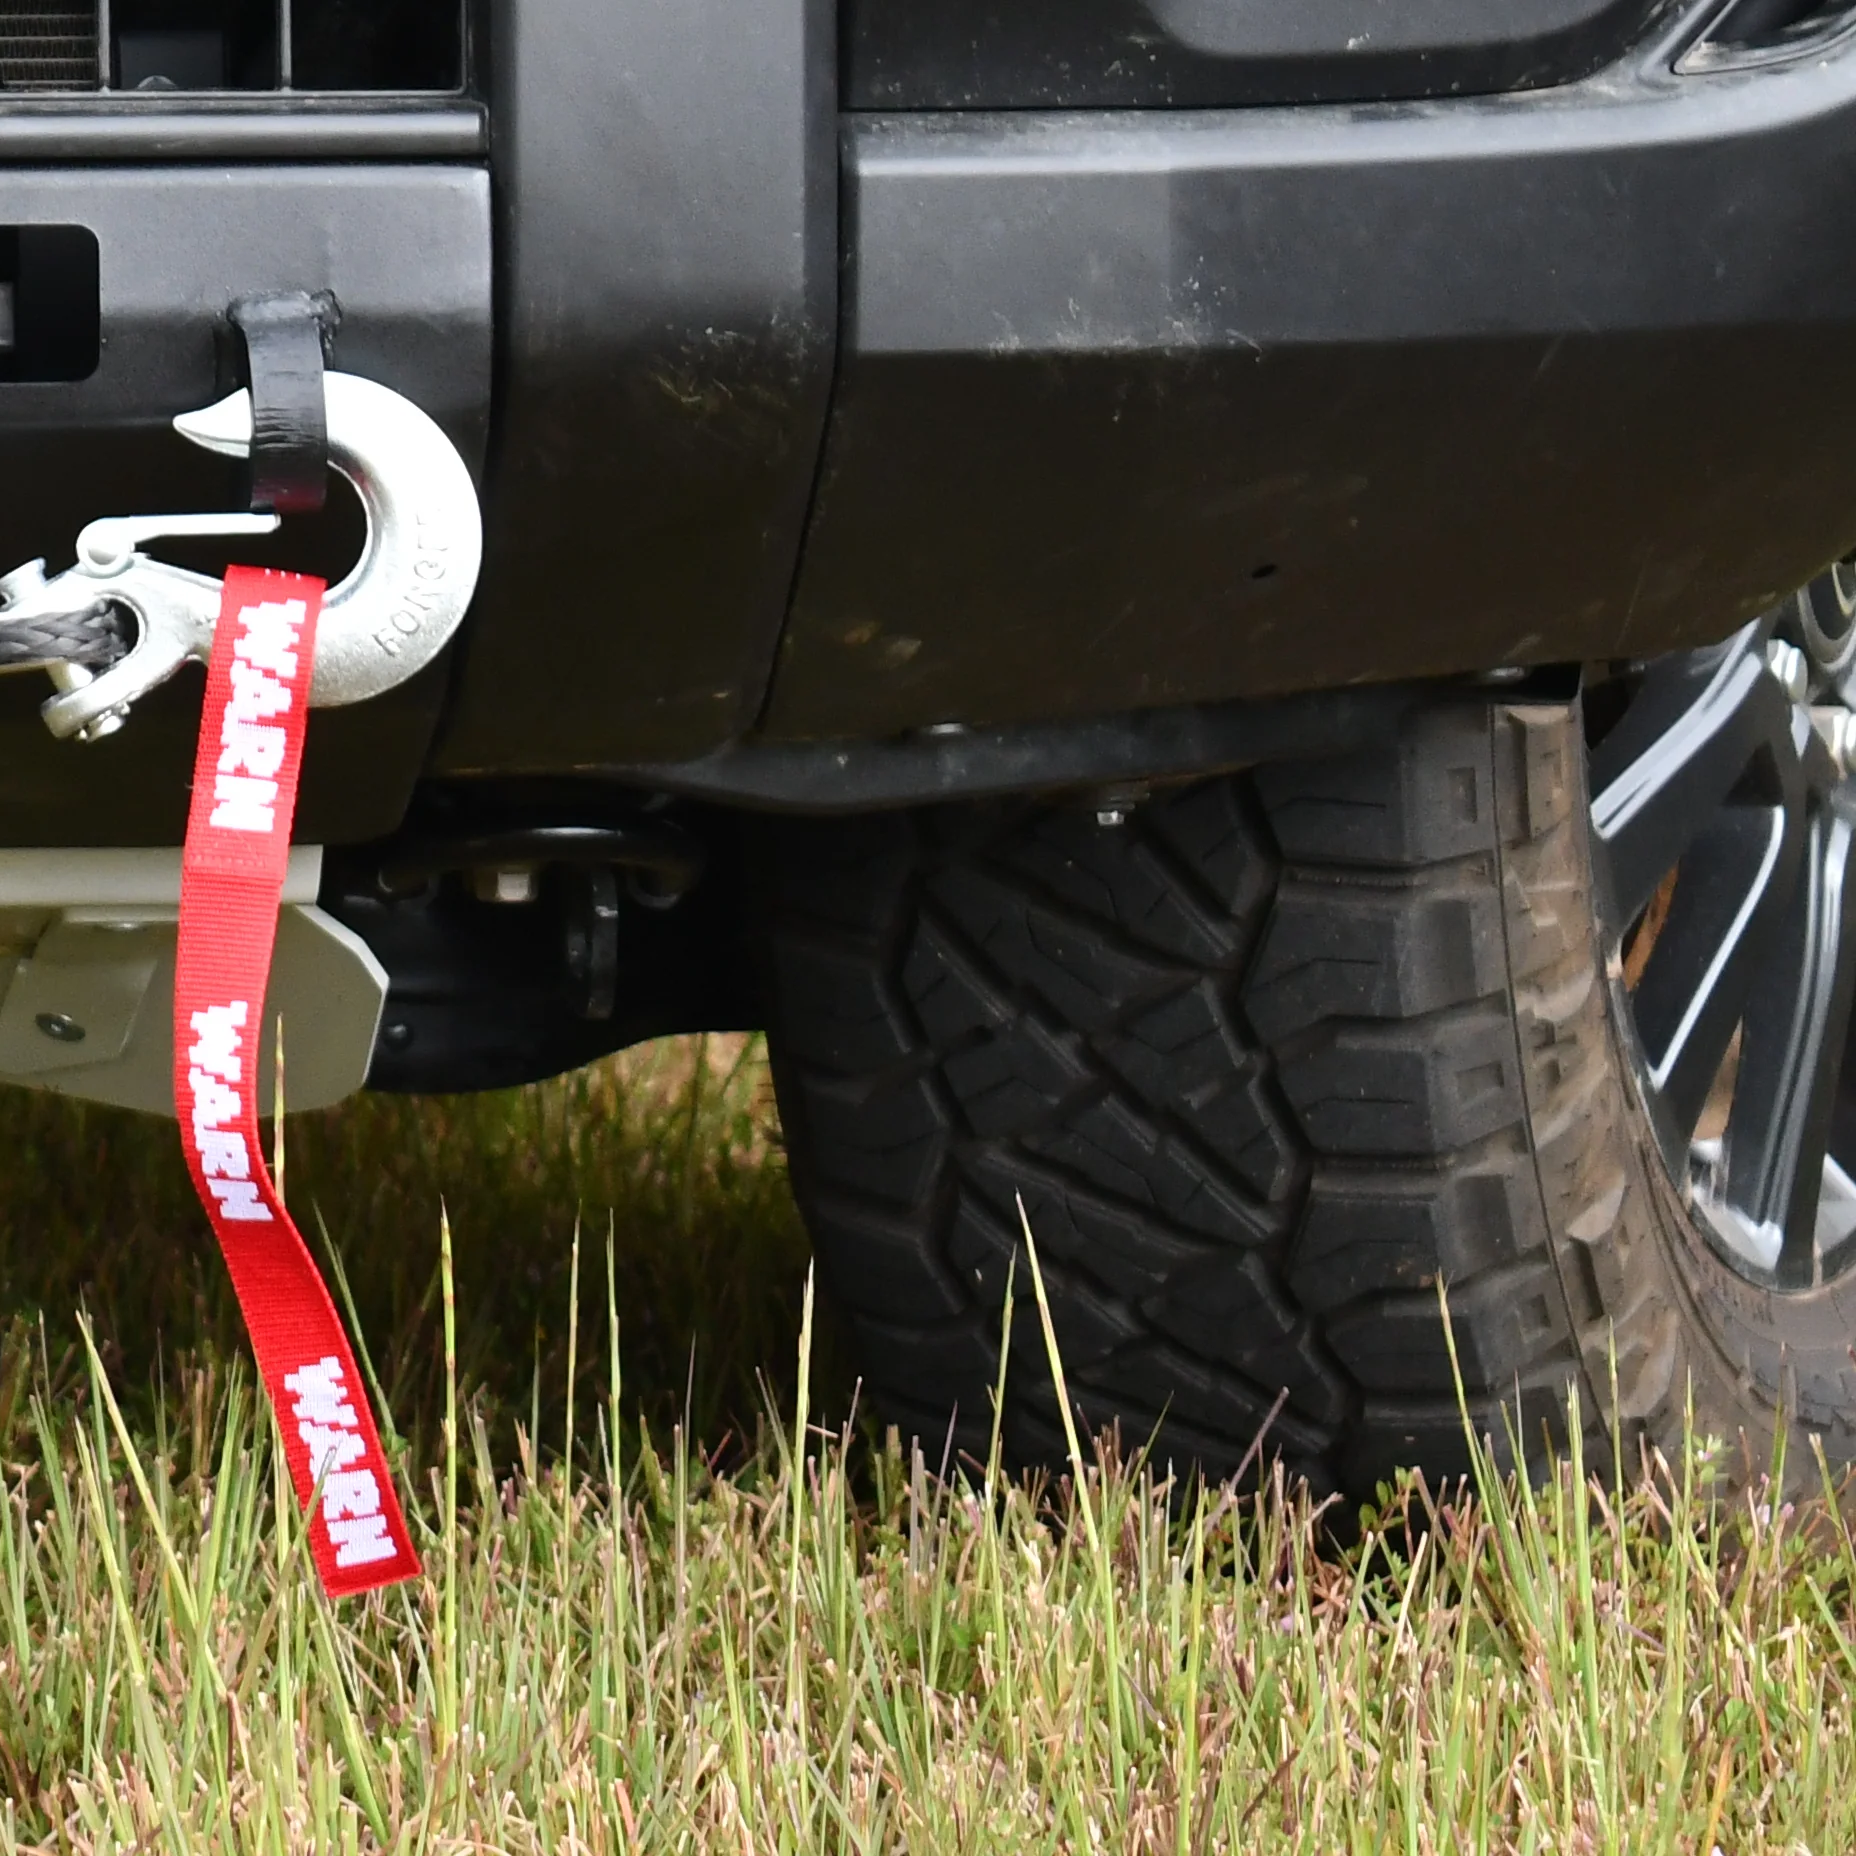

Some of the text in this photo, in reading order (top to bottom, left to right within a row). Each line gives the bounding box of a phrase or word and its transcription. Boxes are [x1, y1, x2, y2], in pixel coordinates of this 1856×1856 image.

[209, 598, 306, 833] WARN
[188, 1000, 275, 1220] WARN
[284, 1355, 398, 1569] WARN
